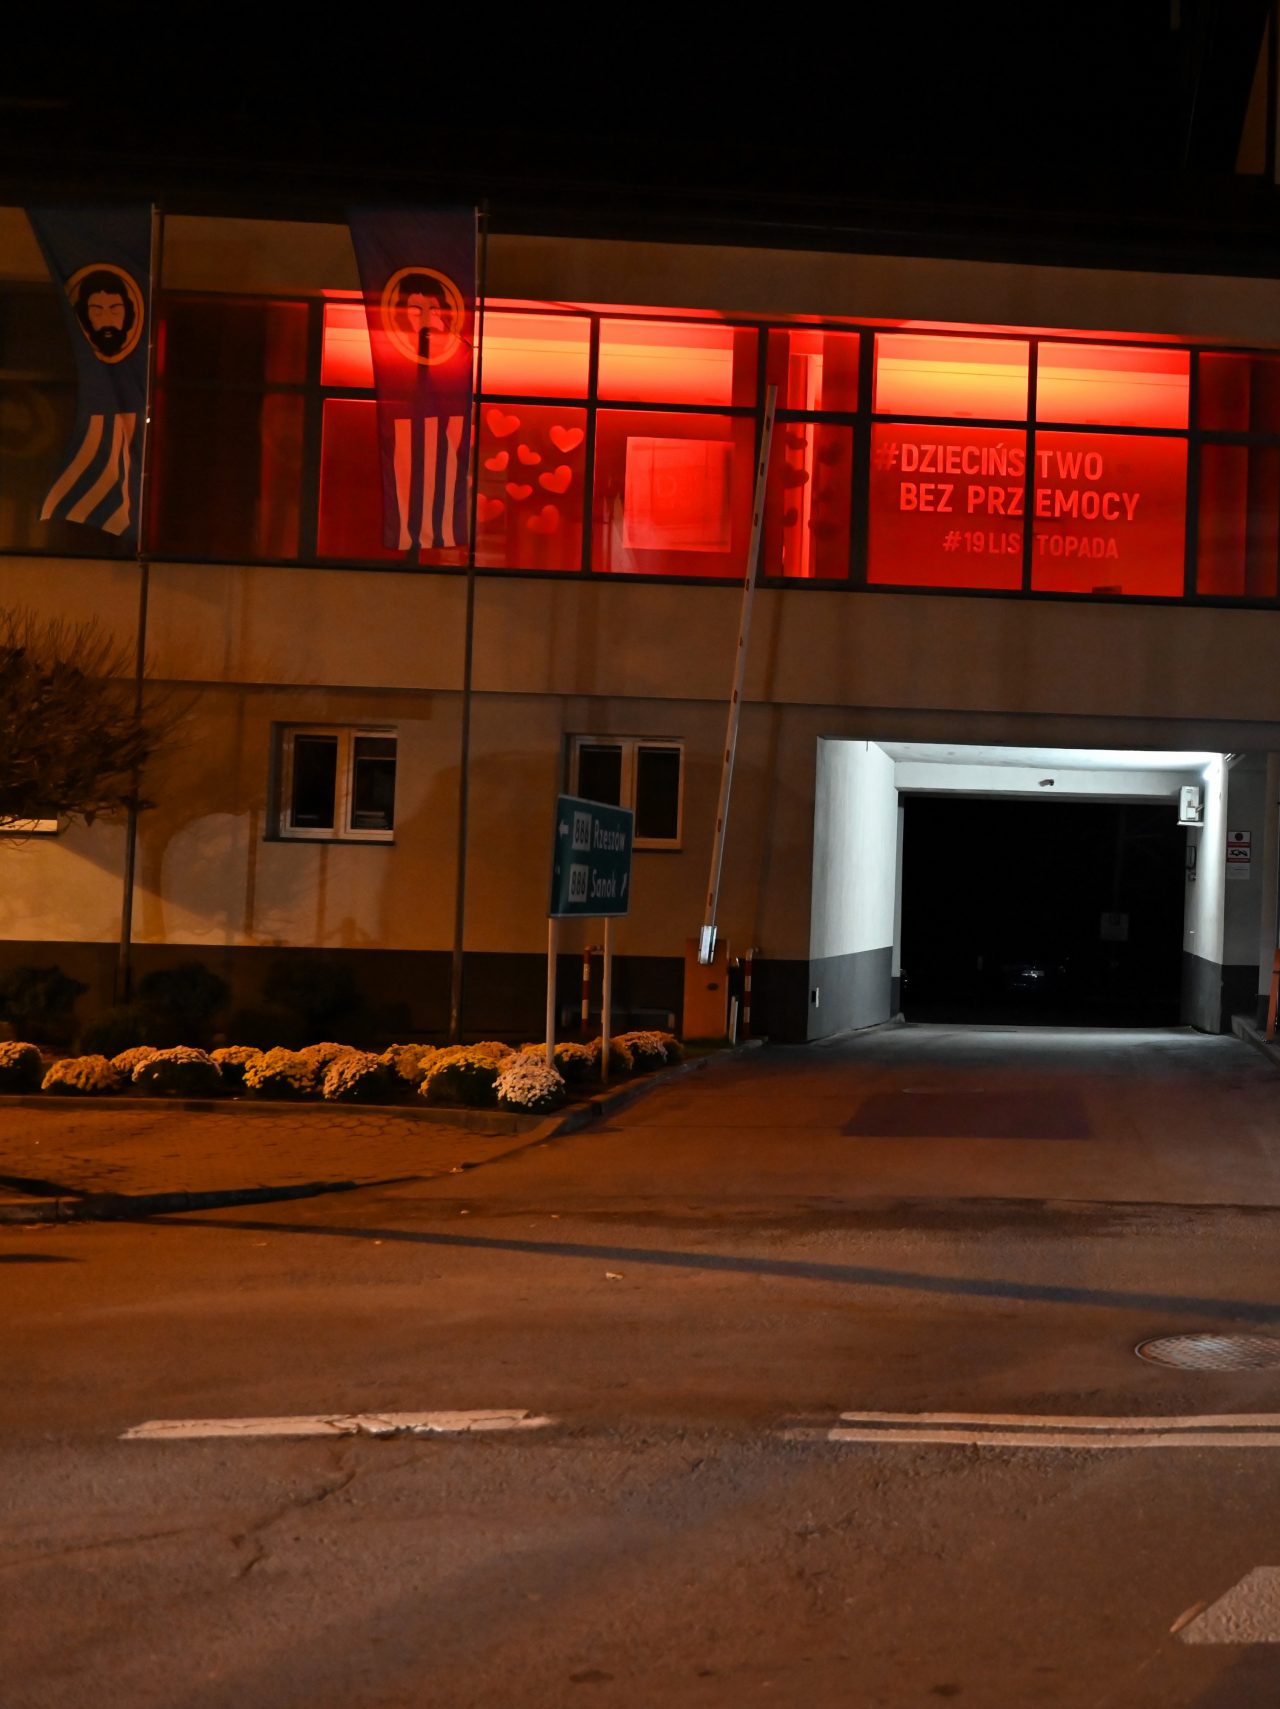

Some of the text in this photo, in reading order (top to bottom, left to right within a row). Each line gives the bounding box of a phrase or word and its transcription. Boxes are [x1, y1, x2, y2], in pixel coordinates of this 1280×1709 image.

[899, 482, 1140, 521] BEZ PRZEMOCY
[593, 819, 626, 851] Rzeszów
[591, 869, 617, 898] Sanok
